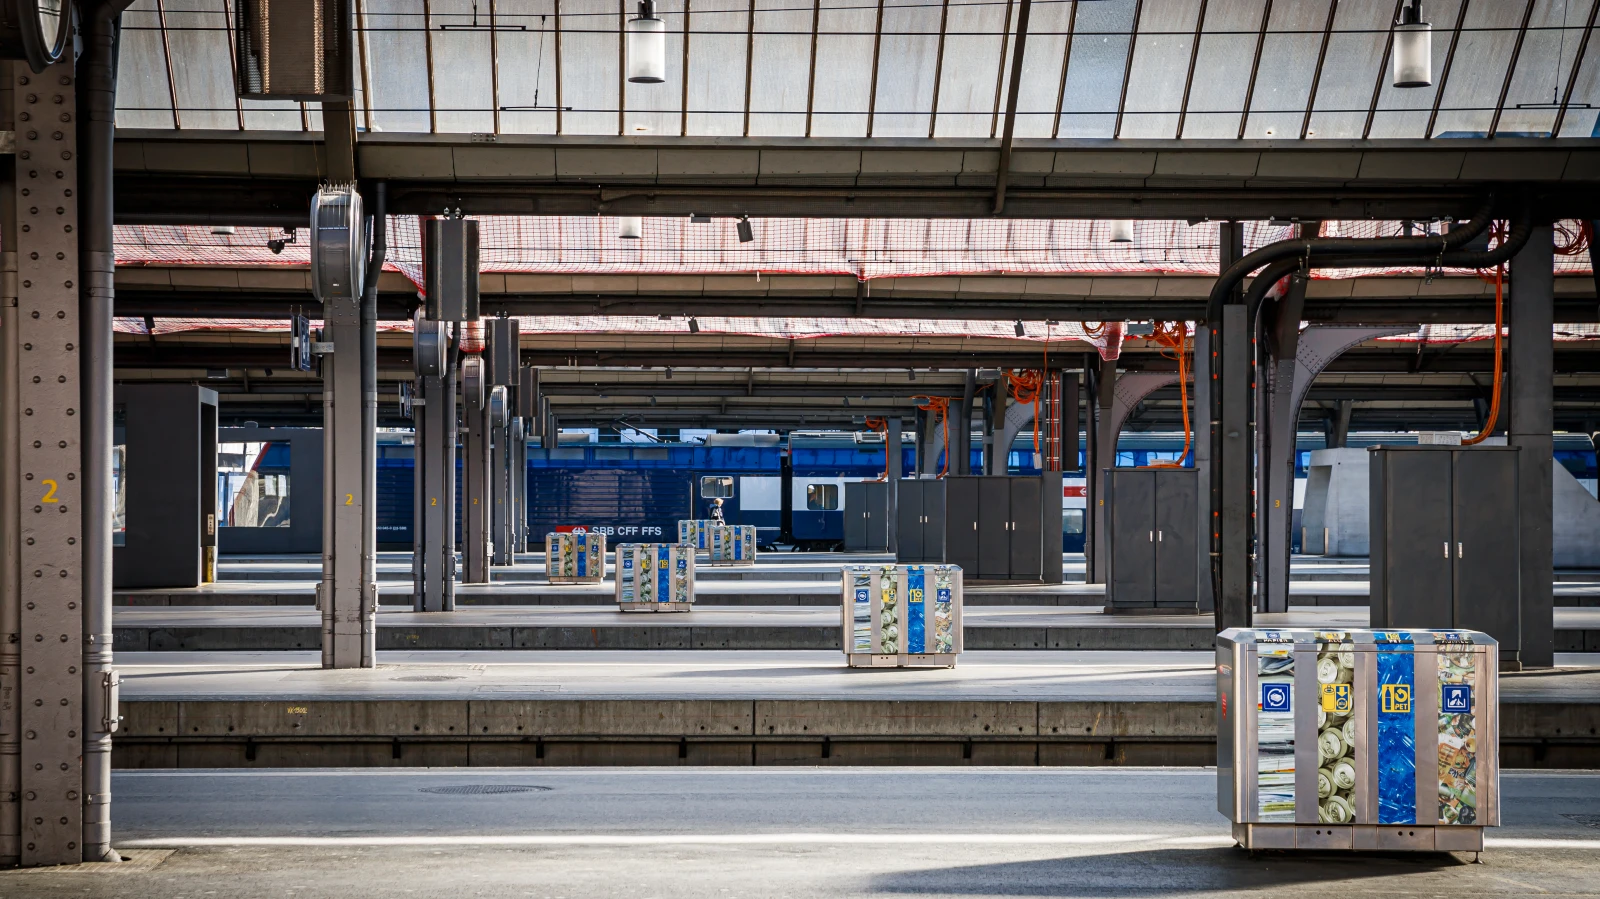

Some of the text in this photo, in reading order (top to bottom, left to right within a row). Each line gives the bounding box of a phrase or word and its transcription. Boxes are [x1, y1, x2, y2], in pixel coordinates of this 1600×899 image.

[41, 479, 59, 503] 2
[345, 493, 354, 506] 2
[431, 497, 437, 506] 2
[1274, 499, 1281, 508] 3
[592, 526, 662, 536] SBB CFF FFS
